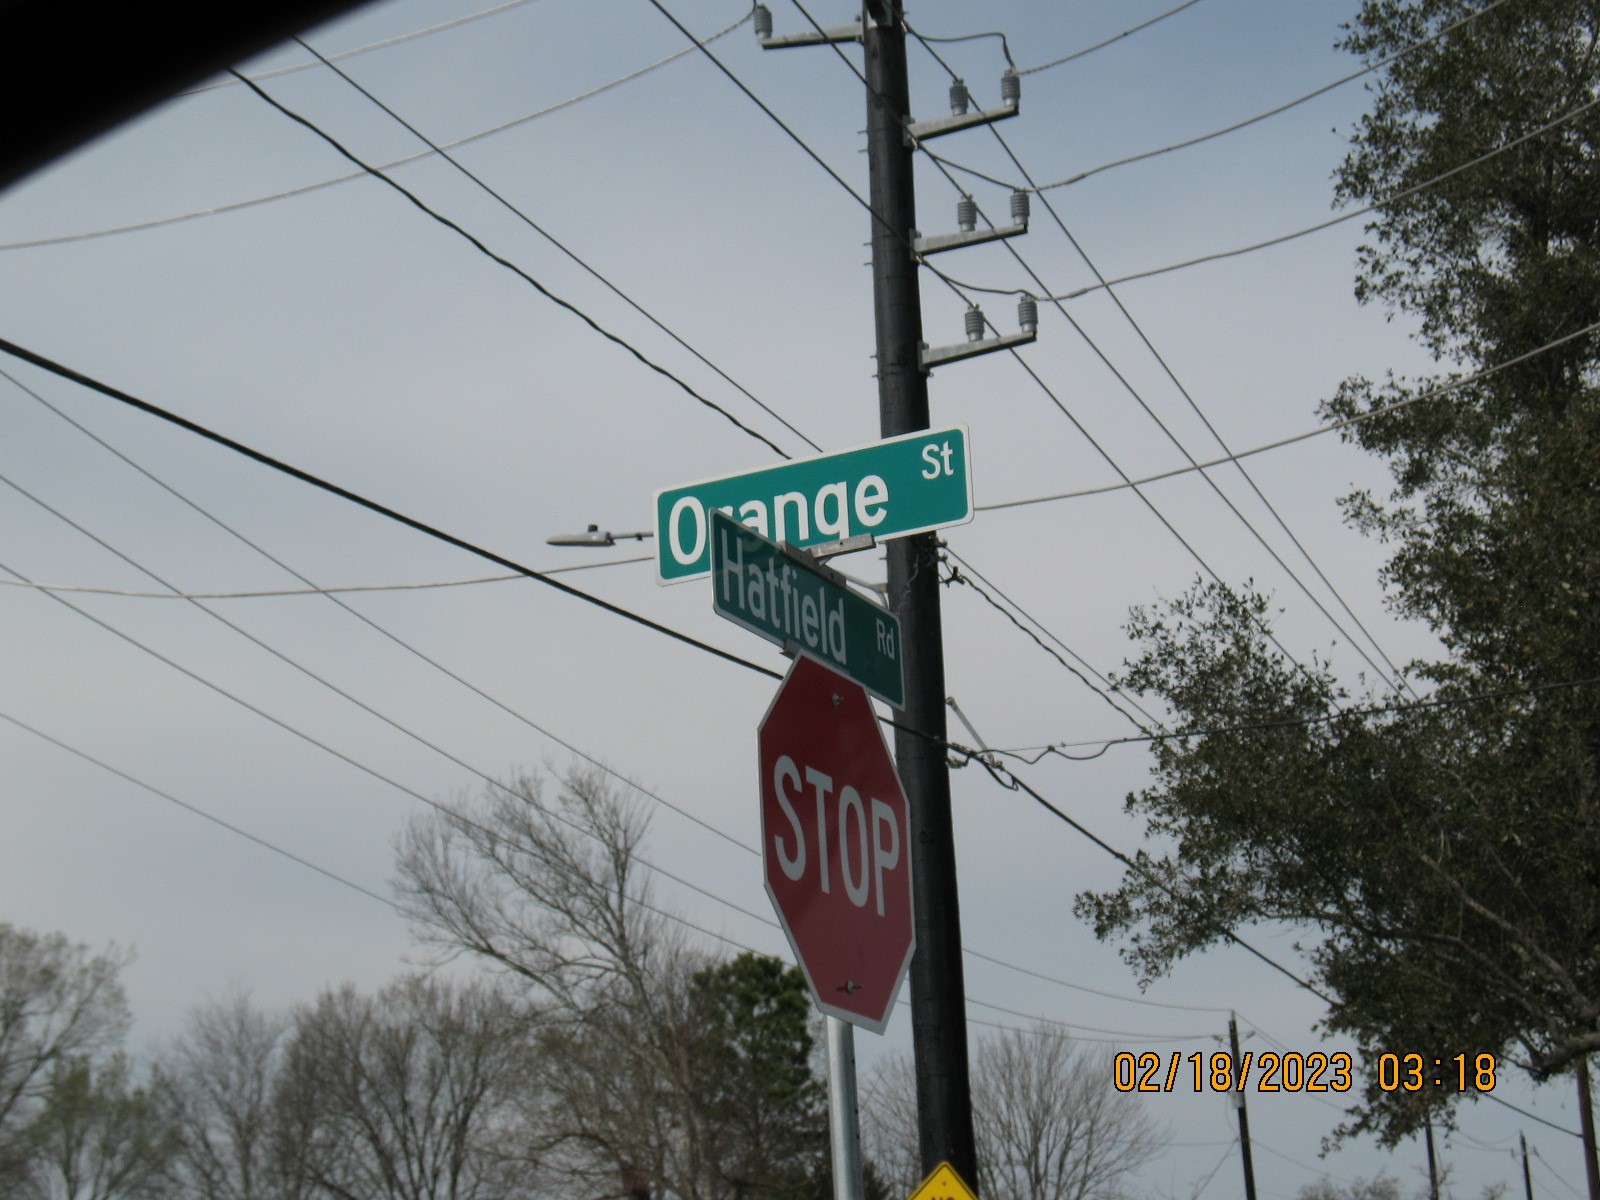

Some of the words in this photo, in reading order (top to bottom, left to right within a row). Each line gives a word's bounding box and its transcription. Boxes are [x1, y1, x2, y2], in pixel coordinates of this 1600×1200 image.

[669, 474, 889, 566] Oange
[921, 440, 954, 480] St
[721, 528, 847, 665] Hatfield
[876, 618, 895, 660] Rd
[774, 755, 900, 917] STOP
